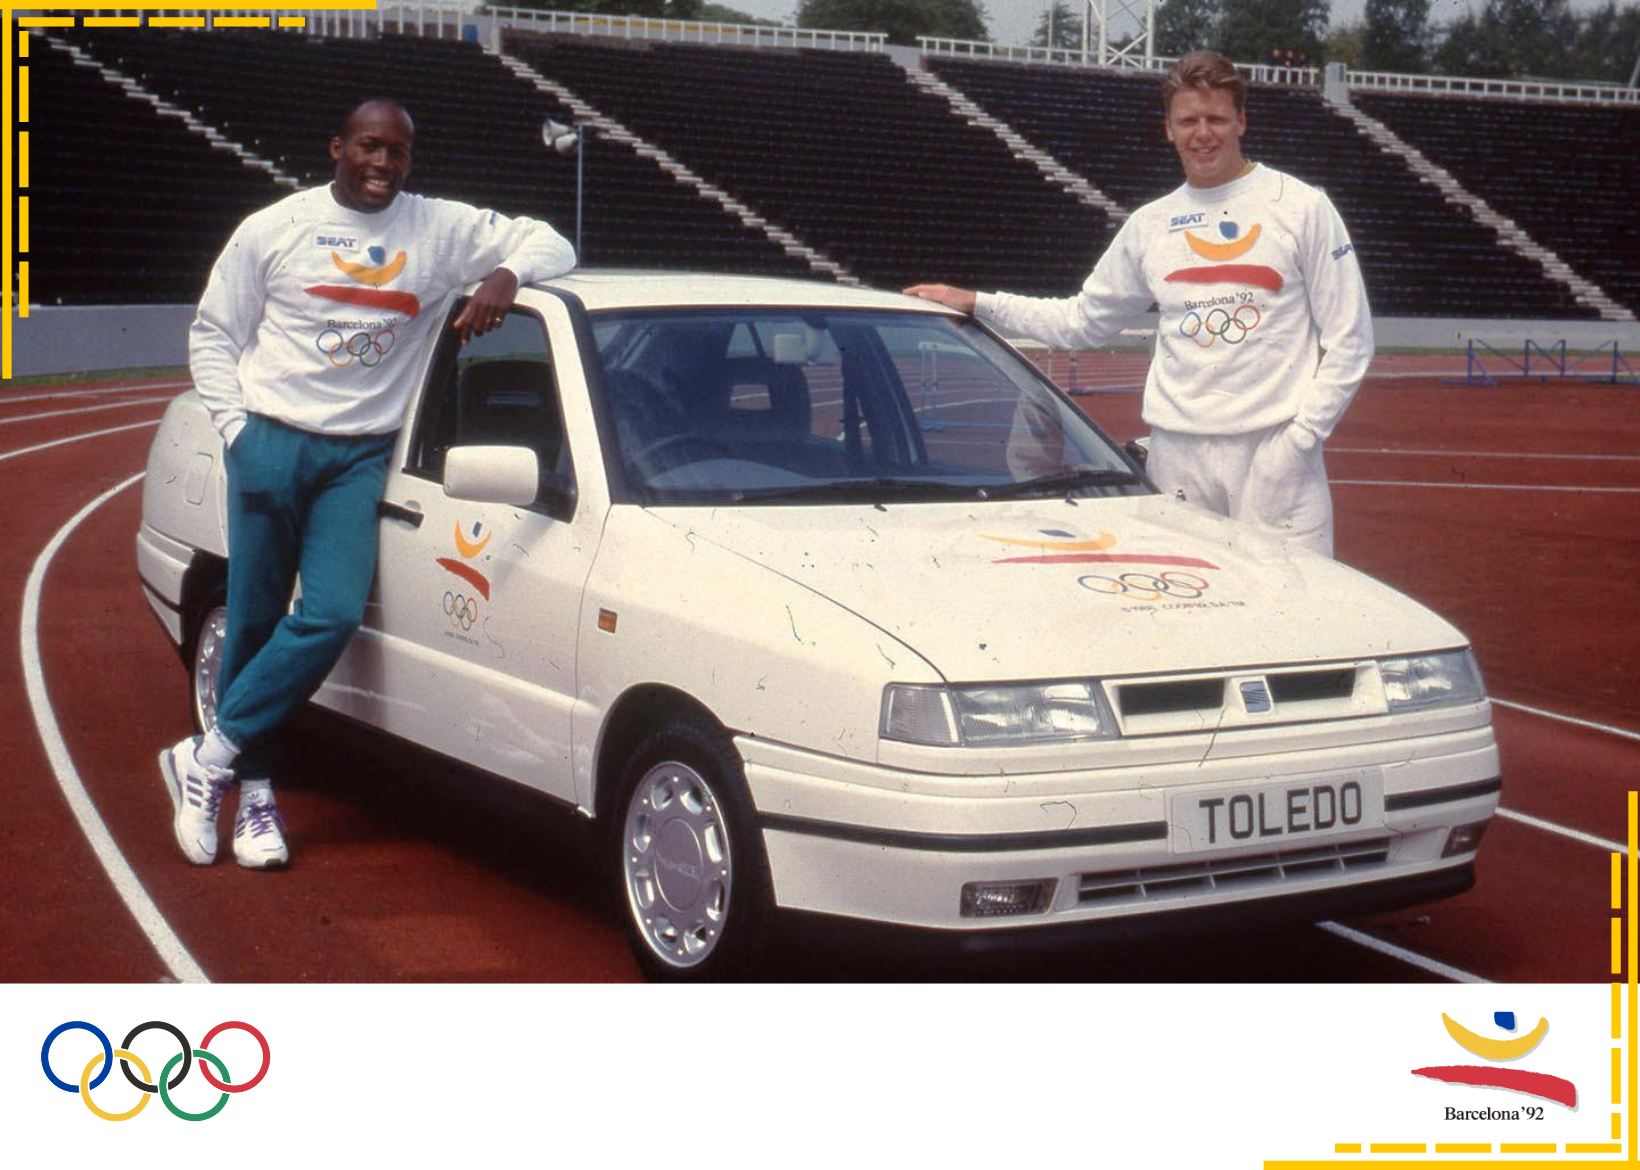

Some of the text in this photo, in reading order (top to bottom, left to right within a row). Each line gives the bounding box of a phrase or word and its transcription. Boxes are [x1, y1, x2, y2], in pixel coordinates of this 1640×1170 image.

[1170, 212, 1205, 227] SEAT
[316, 236, 357, 248] SEAT
[1331, 244, 1353, 261] SEA
[1184, 295, 1236, 311] Barcelona
[327, 318, 382, 330] Barcelona
[1198, 781, 1362, 844] TOLEDO
